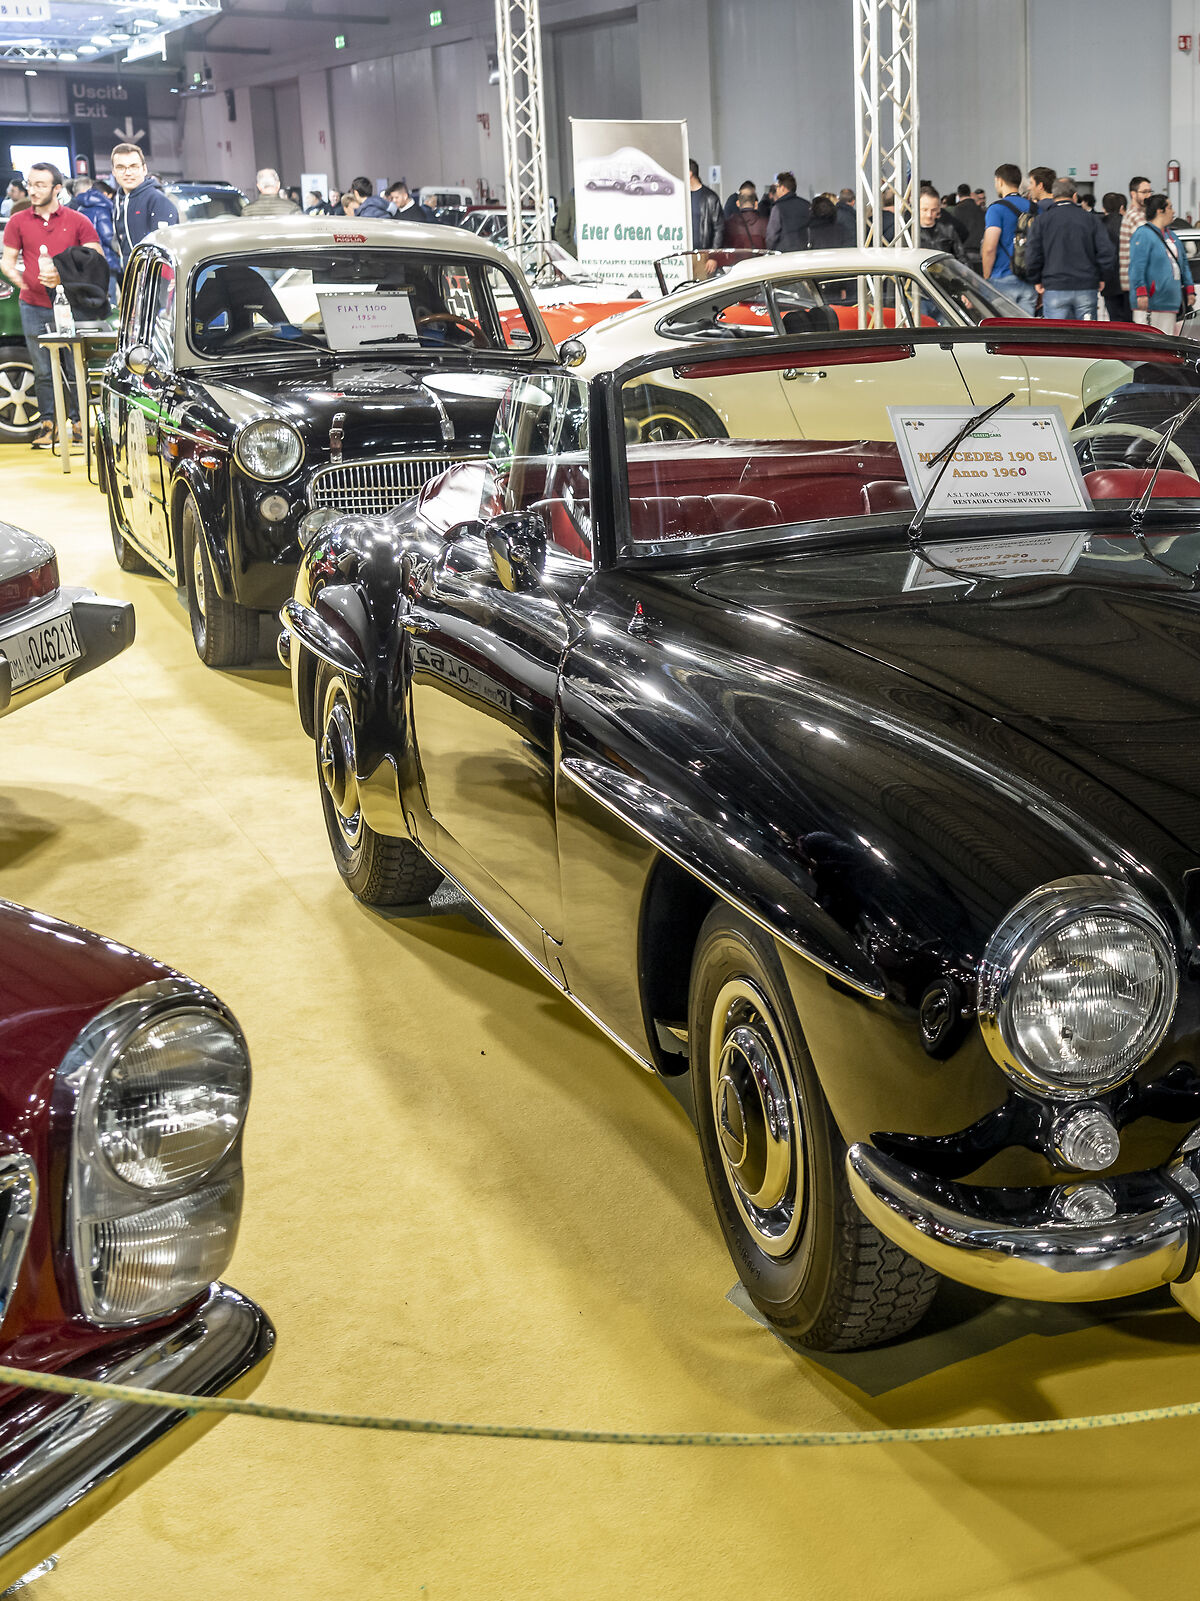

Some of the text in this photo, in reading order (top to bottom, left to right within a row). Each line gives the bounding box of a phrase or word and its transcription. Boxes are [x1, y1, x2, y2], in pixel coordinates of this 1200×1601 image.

[72, 84, 128, 100] Uscita
[74, 103, 108, 118] Exit
[582, 223, 684, 240] Ever Green Cars
[337, 305, 359, 313] FIAT
[1007, 451, 1035, 462] 190
[1038, 452, 1057, 462] SL
[952, 467, 1027, 478] Anno 1960
[28, 619, 80, 669] 04621X
